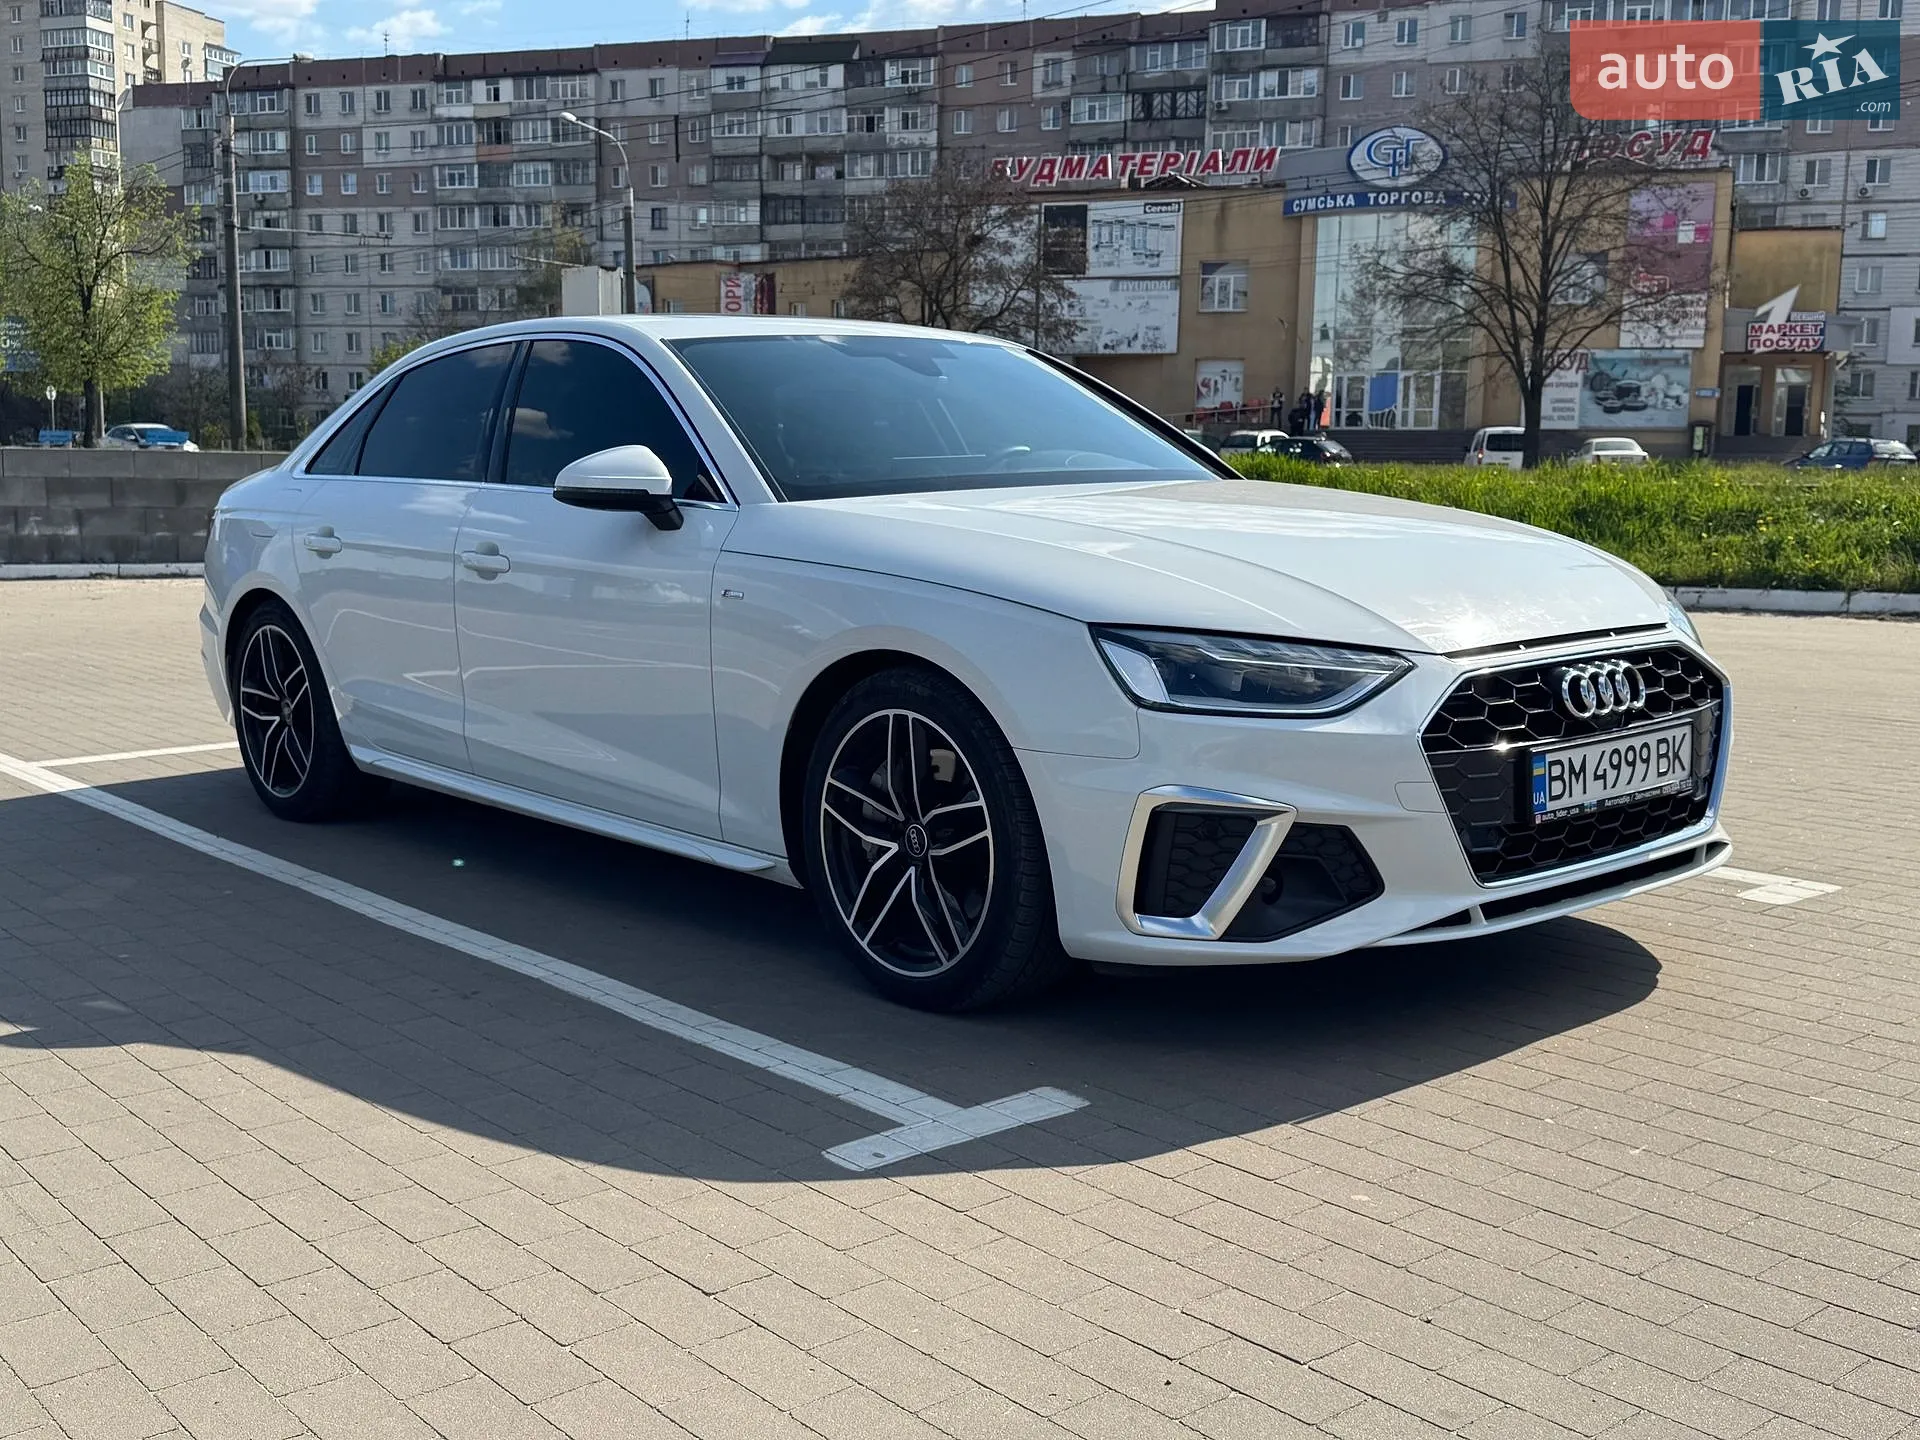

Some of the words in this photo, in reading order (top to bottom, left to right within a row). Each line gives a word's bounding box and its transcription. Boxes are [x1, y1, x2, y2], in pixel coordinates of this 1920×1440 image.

[1145, 202, 1179, 213] Ceresit
[1292, 193, 1356, 212] СУМСЬКА
[1367, 190, 1447, 206] ТОРГОВА
[1118, 280, 1171, 292] HYUNDAI
[1749, 323, 1823, 335] МАРКЕТ
[1749, 337, 1823, 352] ПОСУДУ
[1547, 753, 1587, 802] BM
[1593, 741, 1651, 790] 4999
[1656, 732, 1687, 778] BK
[1533, 791, 1546, 805] UA
